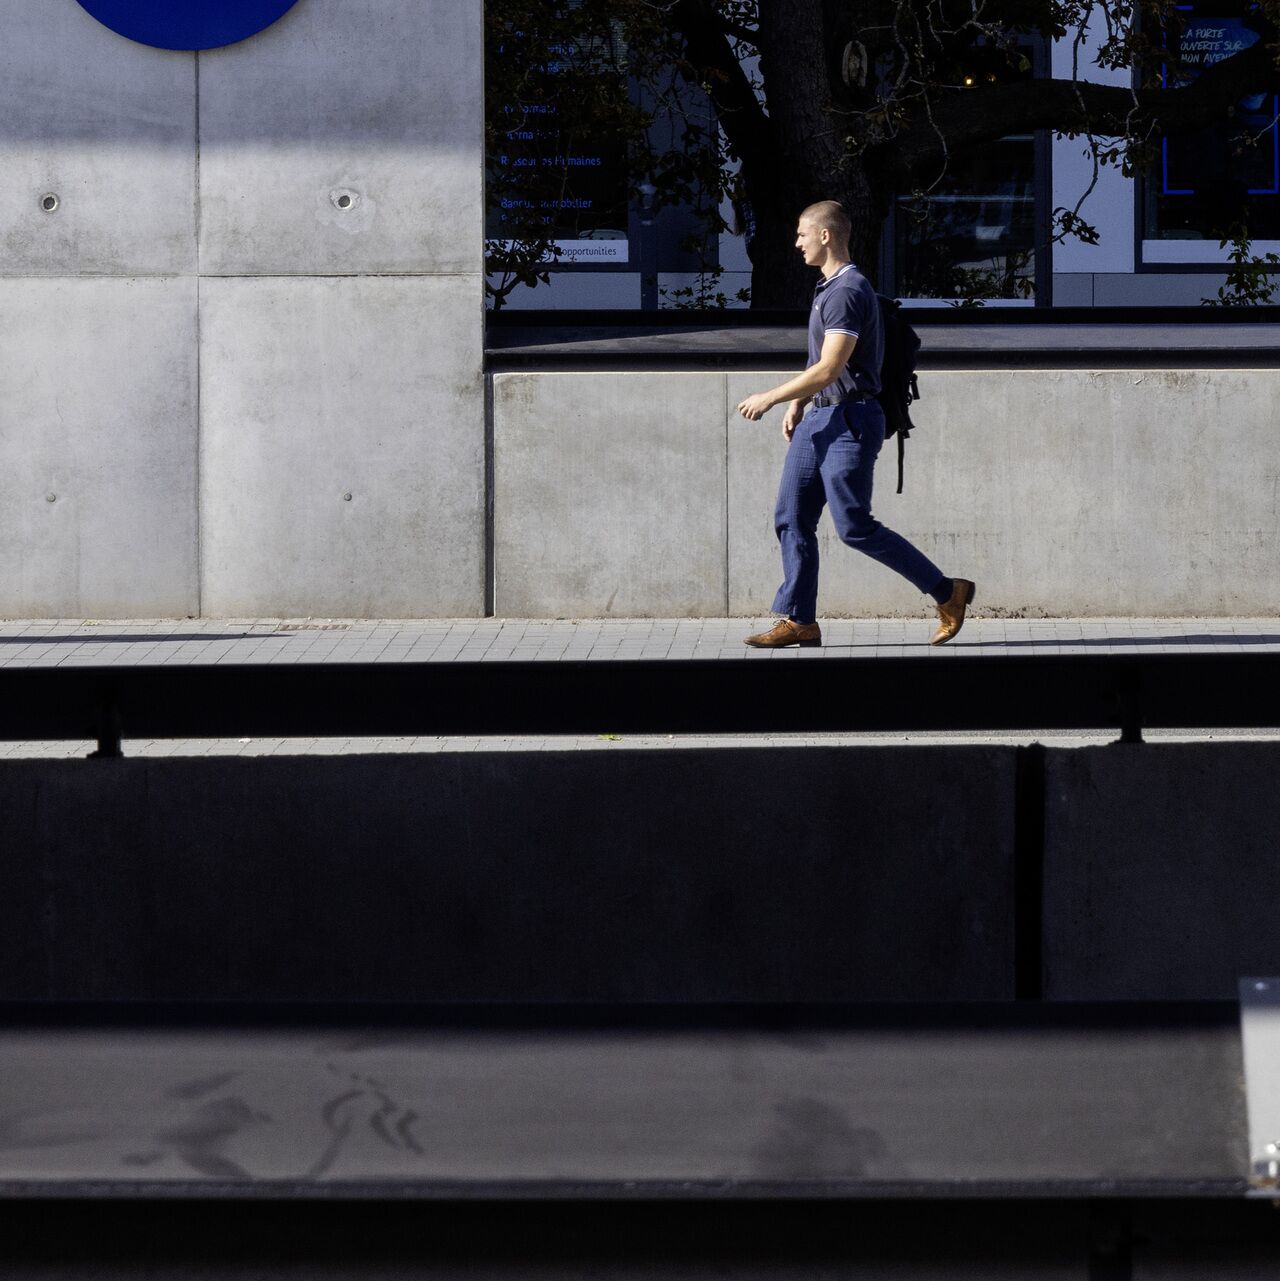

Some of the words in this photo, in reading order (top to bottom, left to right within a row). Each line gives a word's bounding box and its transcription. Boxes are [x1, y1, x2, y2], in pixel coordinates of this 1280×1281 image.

[1195, 28, 1227, 39] PORTE
[1180, 40, 1223, 51] OUVERTE
[1224, 40, 1243, 51] SUR
[1181, 53, 1200, 63] MON
[562, 247, 617, 257] opportunities
